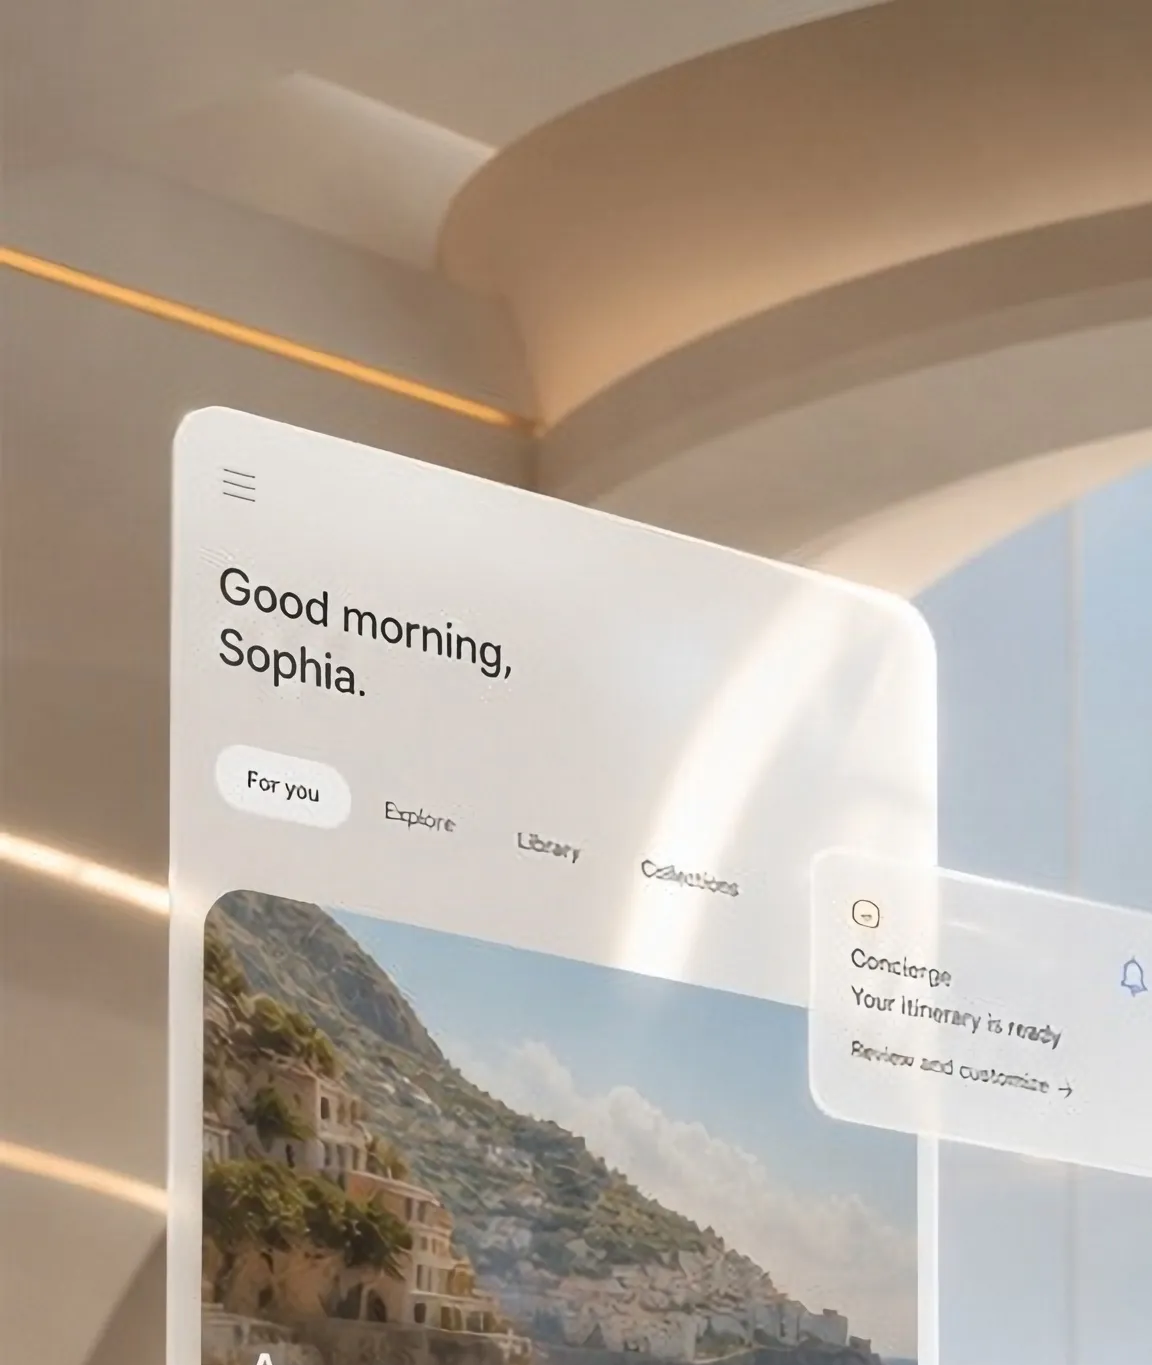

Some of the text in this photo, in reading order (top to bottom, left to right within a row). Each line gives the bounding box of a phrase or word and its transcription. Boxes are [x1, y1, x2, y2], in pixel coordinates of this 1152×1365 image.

[220, 568, 511, 680] Good morning,
[219, 626, 365, 696] Sophia.
[248, 770, 319, 802] For you
[851, 986, 895, 1011] Your
